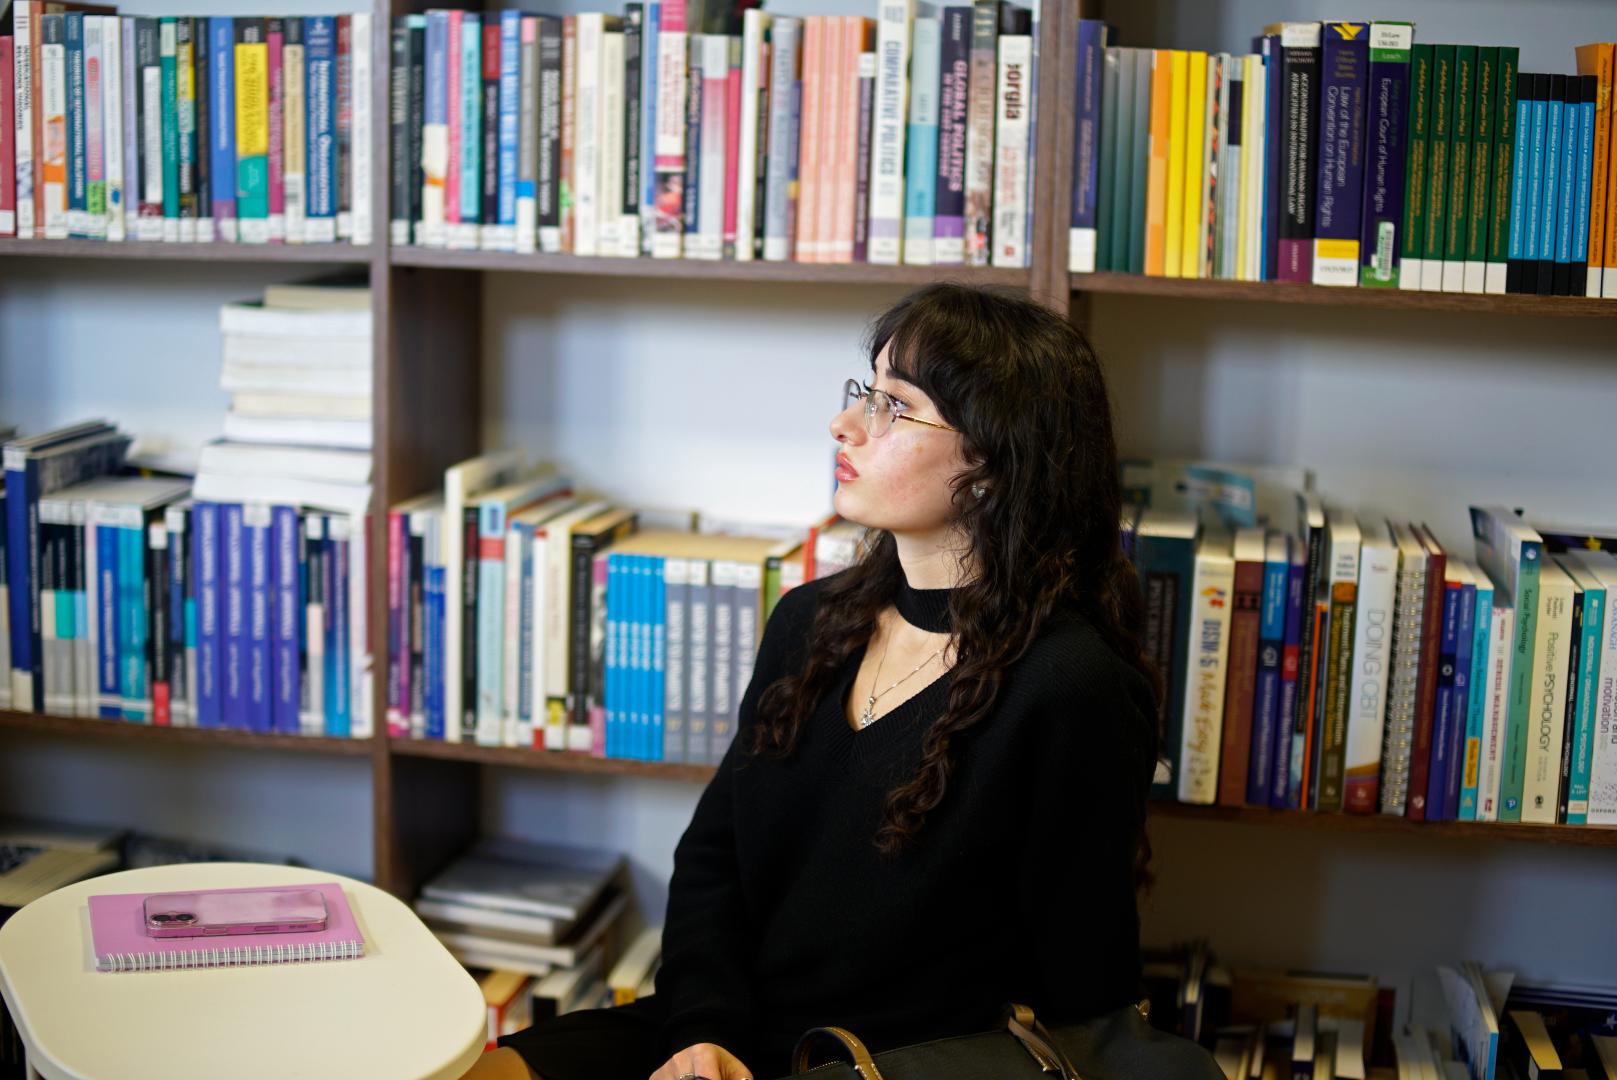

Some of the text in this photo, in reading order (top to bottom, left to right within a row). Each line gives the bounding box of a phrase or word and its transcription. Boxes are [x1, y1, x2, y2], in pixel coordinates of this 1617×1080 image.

[74, 50, 82, 86] THEORIES
[180, 46, 189, 61] THE
[779, 50, 790, 84] NATO
[944, 72, 953, 85] IN
[880, 41, 901, 175] COMPARATIVE POLITICS
[943, 87, 952, 107] THE
[74, 98, 83, 157] INTERNATIONAL
[180, 132, 190, 160] THEORY
[317, 60, 332, 214] INTERNATIONAL ORGANIZATIONS
[949, 60, 967, 191] GLOBAL POLITICS
[977, 76, 990, 183] CRIMINOLOGY
[1287, 72, 1299, 215] ATROCITIES IN INTERNATIONAL LAW
[1297, 72, 1309, 224] ACCOUNTABILITY FOR HUMAN RIGHTS
[1334, 87, 1350, 187] Law of the European
[1373, 78, 1392, 213] European Court of Human Rights
[74, 158, 83, 199] RELATIONS
[180, 162, 191, 193] PRIMER
[940, 132, 951, 177] CENTURY
[1321, 86, 1339, 227] Convention on Human Rights
[1200, 620, 1222, 668] DSM-5
[1476, 631, 1486, 665] Cognitive
[1519, 588, 1532, 654] Social Psychology
[1335, 607, 1353, 745] Treatment Plans and Interventions
[1360, 610, 1386, 722] DOING CBT
[1586, 636, 1595, 673] INDUSTRIAL
[1199, 671, 1218, 712] Made
[1539, 632, 1558, 752] Positive PSYCHOLOGY
[1581, 678, 1592, 732] ORGANIZATIONAL
[1601, 678, 1613, 733] motivation
[1187, 716, 1214, 754] Easy
[1578, 733, 1587, 774] PSYCHOLOGY
